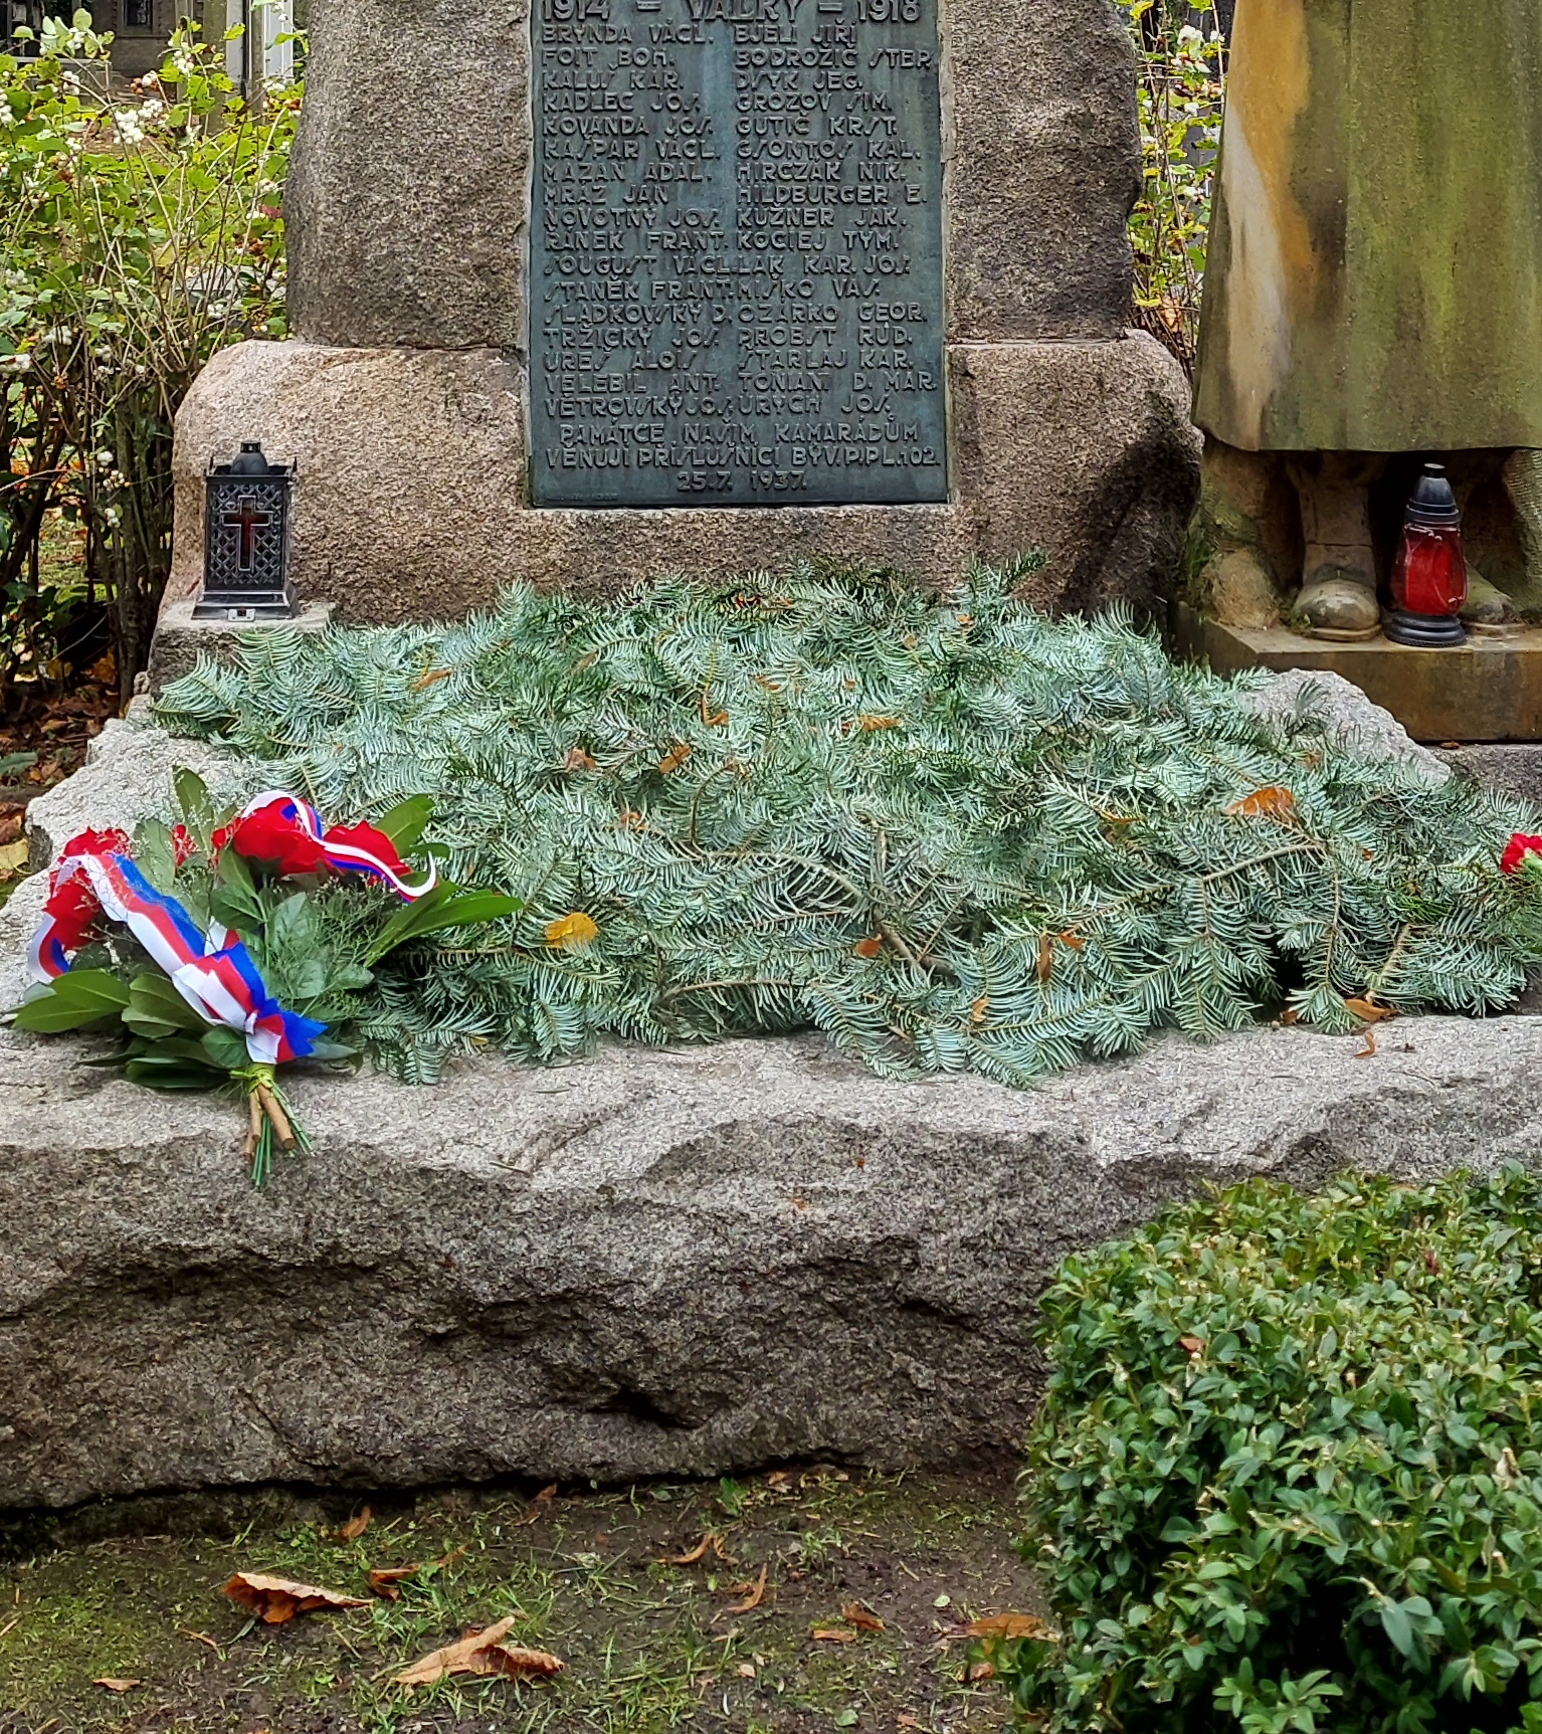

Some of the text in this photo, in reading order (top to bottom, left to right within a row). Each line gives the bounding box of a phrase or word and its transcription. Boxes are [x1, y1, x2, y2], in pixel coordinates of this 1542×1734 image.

[542, 18, 714, 45] BRYNDA VÁCL.
[734, 18, 857, 45] BJELI JIŘÍ
[542, 46, 675, 67] FOIT BOH.
[734, 43, 859, 67] BODROŽIČ
[542, 63, 684, 91] KALUŠ KAR.
[736, 70, 864, 91] DSYK JEG.
[543, 92, 702, 112] KADLEC JOS.
[736, 91, 893, 112] GROZOV SIM.
[542, 115, 714, 136] KOVANDA JOS.
[736, 112, 898, 136] GUTIČ KRST.
[543, 133, 721, 160] KAŠPAR VÁCL.
[867, 139, 922, 160] KAL.
[542, 162, 713, 182] MAZAN ADAL.
[736, 157, 907, 182] HIRCZÁK NIK.
[543, 180, 669, 205] MRÁZ JAN
[736, 184, 928, 205] HILDBURGER E.
[544, 203, 721, 227] NOVOTNÝ JOS.
[737, 202, 907, 228] KUŽNER JAK.
[646, 231, 729, 251] FRANT.
[737, 230, 899, 251] KOCIEJ TYM.
[544, 249, 737, 276] SOUGUST VÁCL.
[738, 254, 784, 275] LAK
[803, 254, 857, 275] KAR.
[544, 274, 734, 301] STANĚK FRANT.
[738, 273, 815, 300] MIŠKO
[712, 304, 733, 324] D.
[858, 302, 928, 323] GEOR.
[543, 322, 719, 349] TRŽICKÝ JOS.
[738, 326, 837, 347] PROBST
[544, 345, 697, 371] UREŠ ALOIS
[860, 349, 914, 369] KAR.
[544, 373, 719, 394] VELEBIL ANT.
[853, 372, 873, 391] D.
[884, 371, 938, 391] MAR.
[738, 394, 891, 415] URYCH JOS.
[560, 417, 664, 446] PAMÁTCE
[775, 414, 919, 442] KAMARÁDŮM
[546, 442, 629, 468] VĚNUJÍ
[751, 470, 807, 492] 1937.
